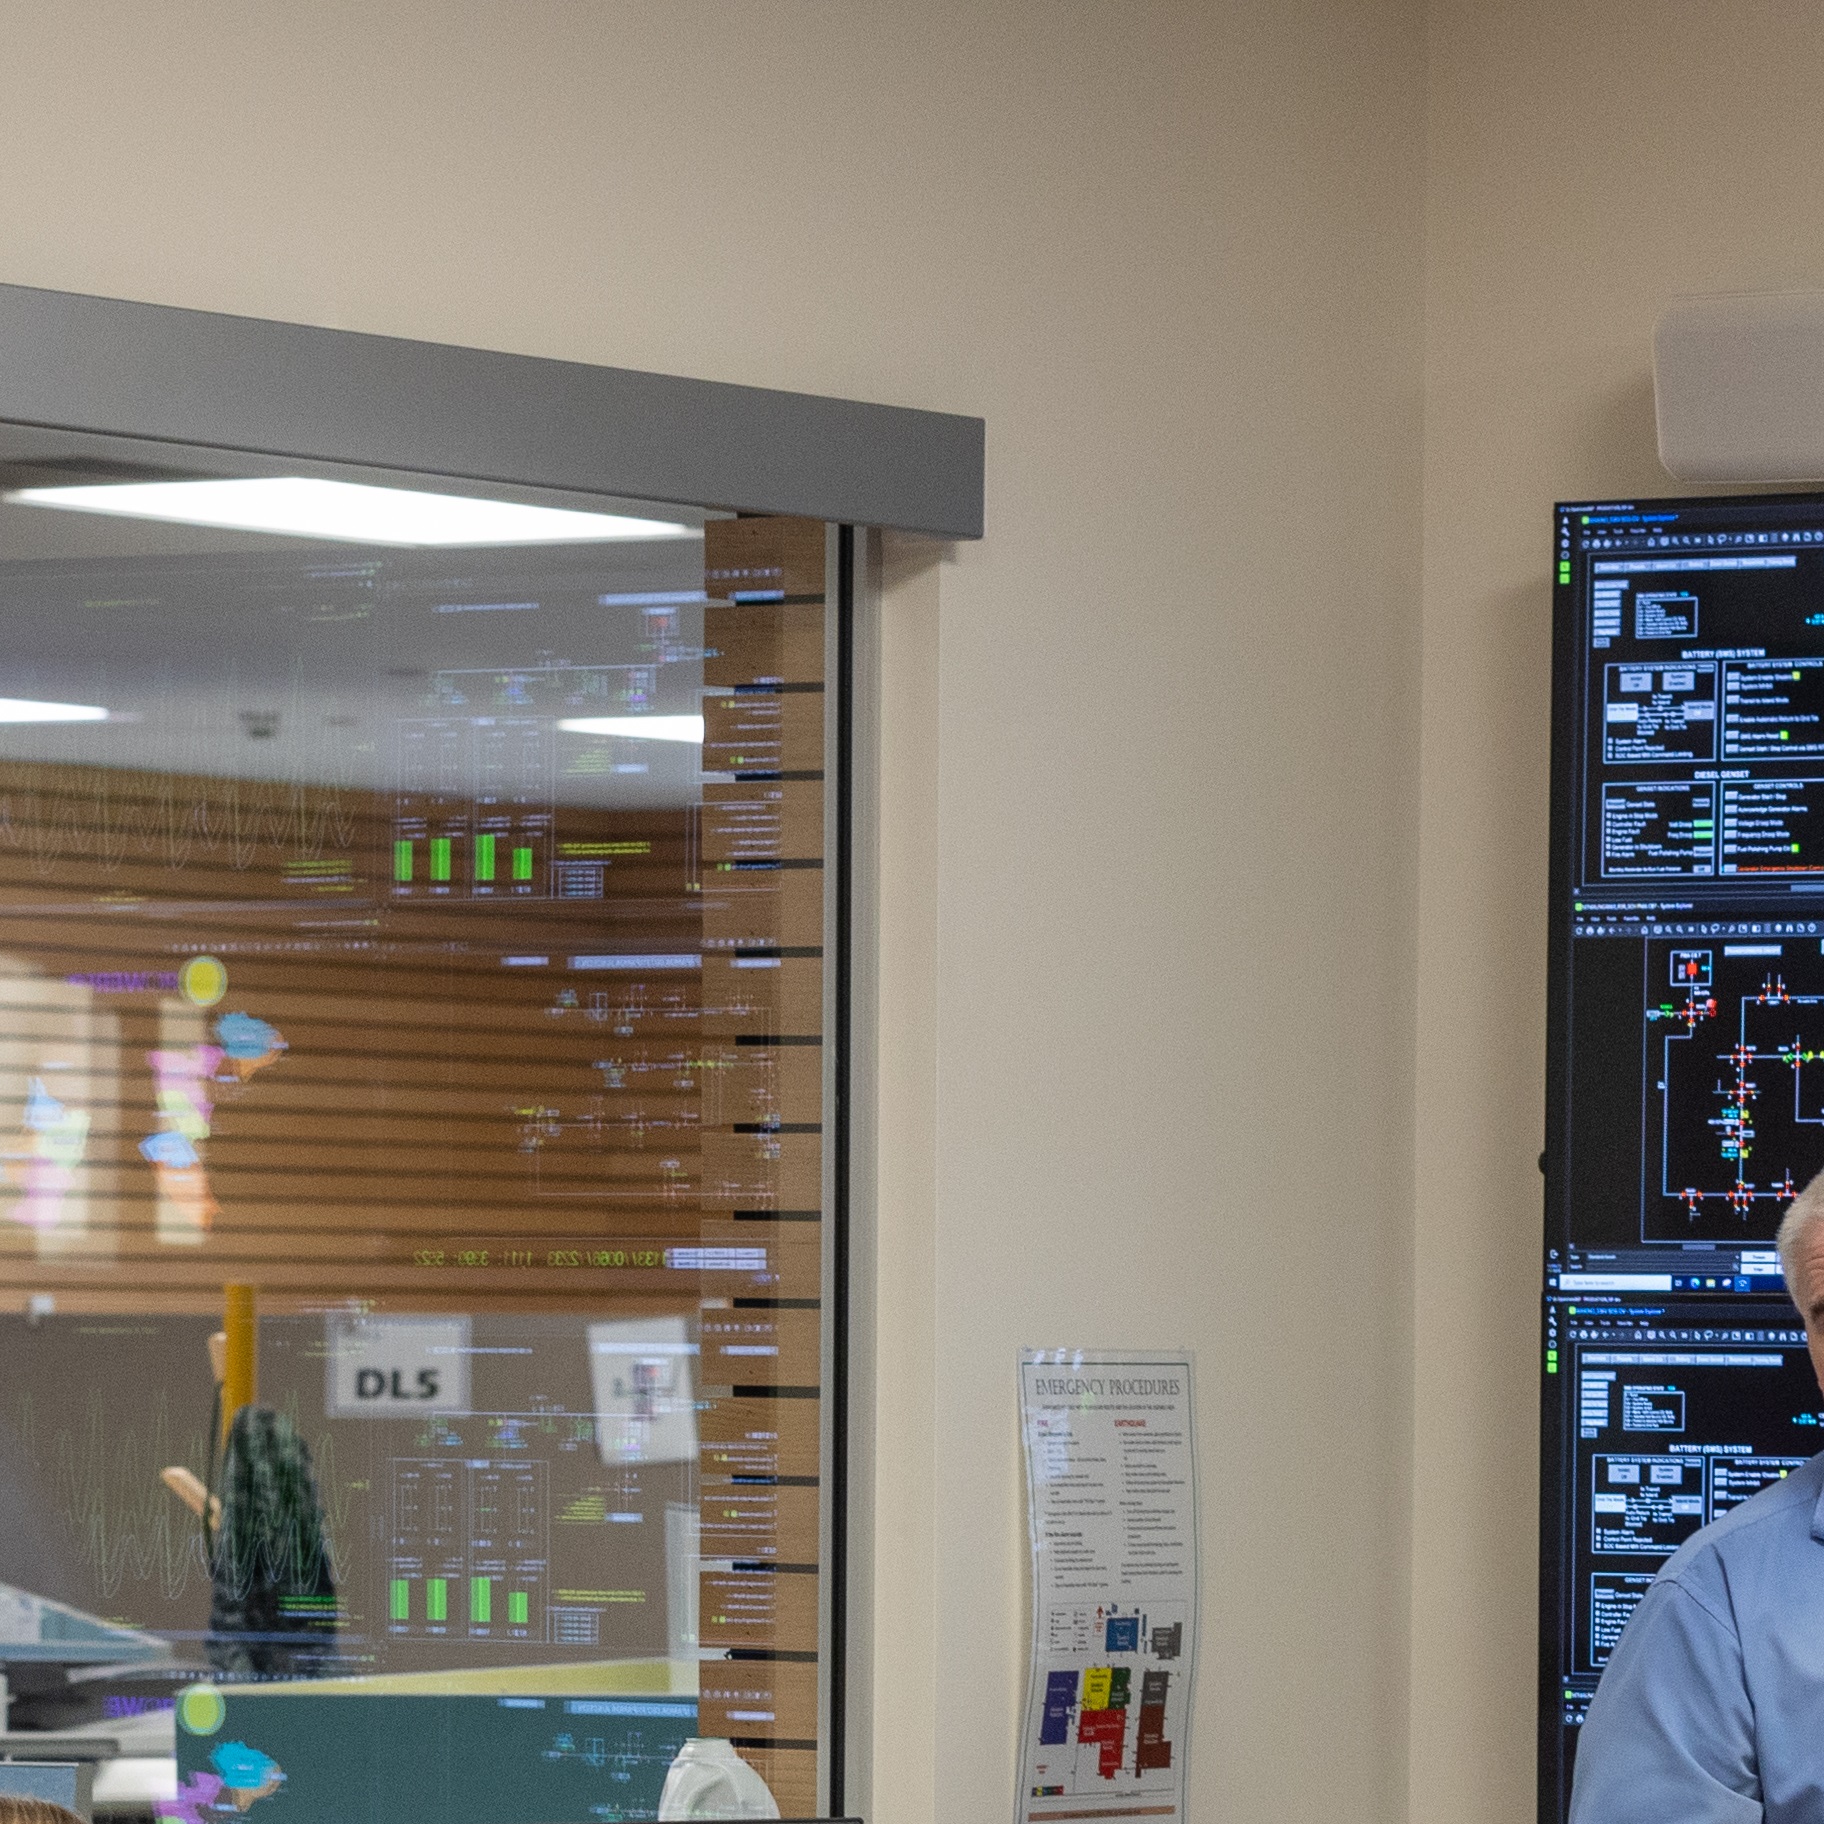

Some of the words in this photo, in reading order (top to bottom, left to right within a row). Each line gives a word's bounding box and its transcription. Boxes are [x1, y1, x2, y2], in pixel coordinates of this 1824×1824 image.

[1682, 650, 1714, 659] BATTERY
[1737, 648, 1765, 657] SYSTEM
[1695, 771, 1719, 779] DIESEL
[1721, 770, 1749, 779] GENSET
[355, 1368, 440, 1400] DL5
[1036, 1379, 1105, 1396] EMERGENCY
[1110, 1379, 1180, 1396] PROCEDURES
